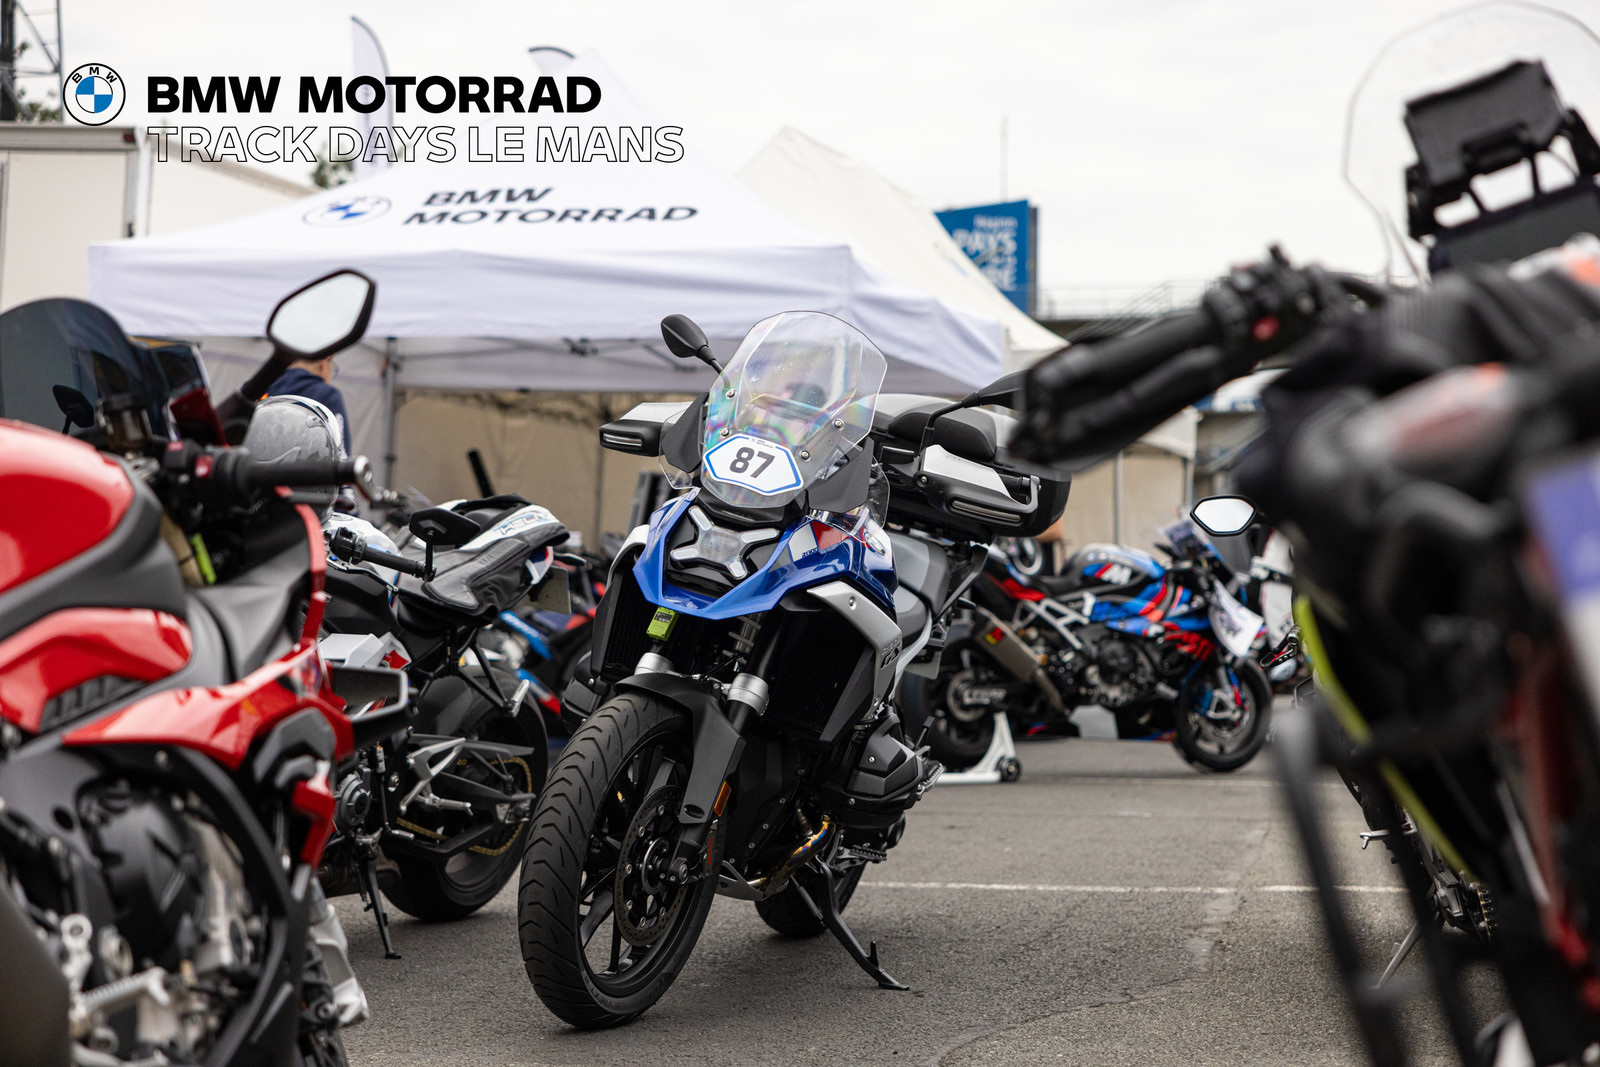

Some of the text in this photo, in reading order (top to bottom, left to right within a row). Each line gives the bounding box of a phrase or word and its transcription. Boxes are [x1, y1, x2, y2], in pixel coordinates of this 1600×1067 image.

[423, 187, 553, 206] BMW
[402, 206, 699, 225] MOTORRAD
[729, 446, 776, 479] 87
